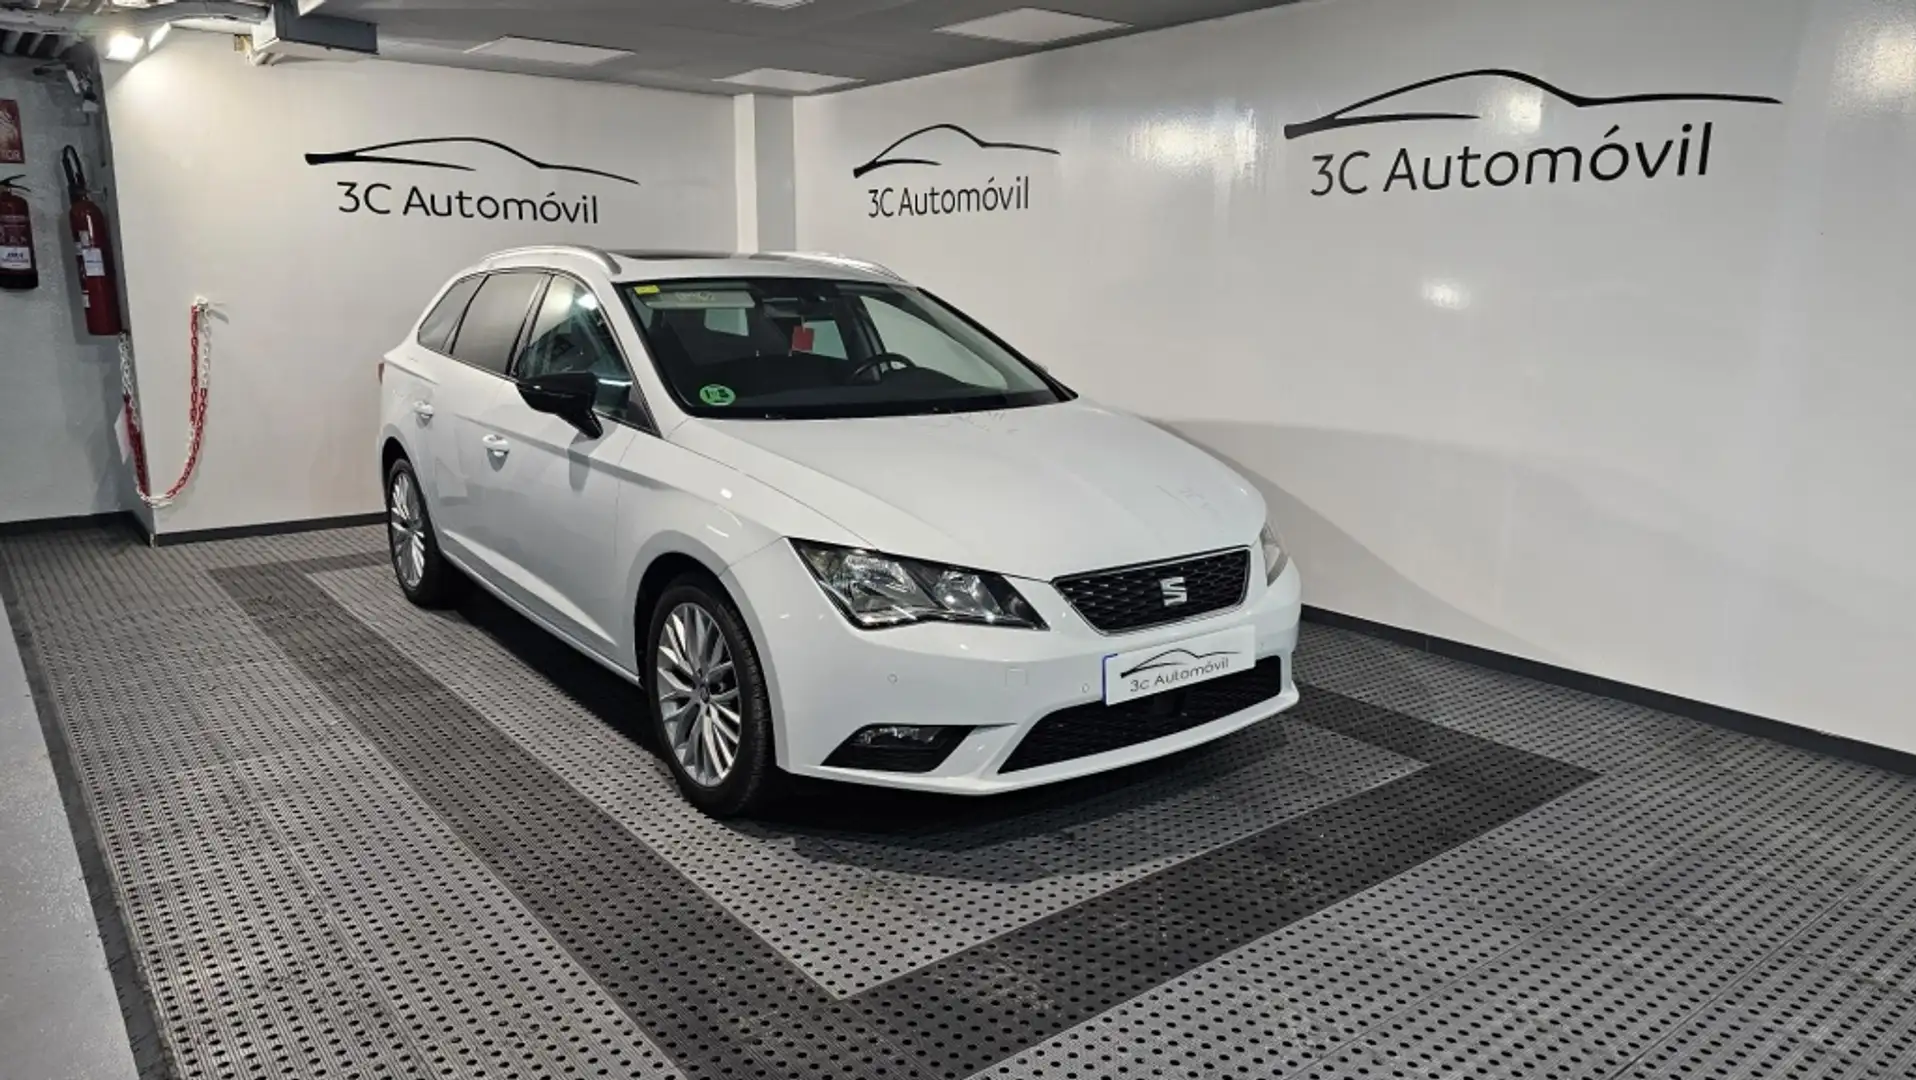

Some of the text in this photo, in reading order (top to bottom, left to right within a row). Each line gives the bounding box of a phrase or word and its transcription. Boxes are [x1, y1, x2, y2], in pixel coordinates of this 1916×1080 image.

[1309, 121, 1714, 197] 3C Automóvil
[336, 181, 599, 225] 3C Automóvil
[867, 175, 1030, 219] 3C Automóvil
[1154, 657, 1229, 685] Automóvil
